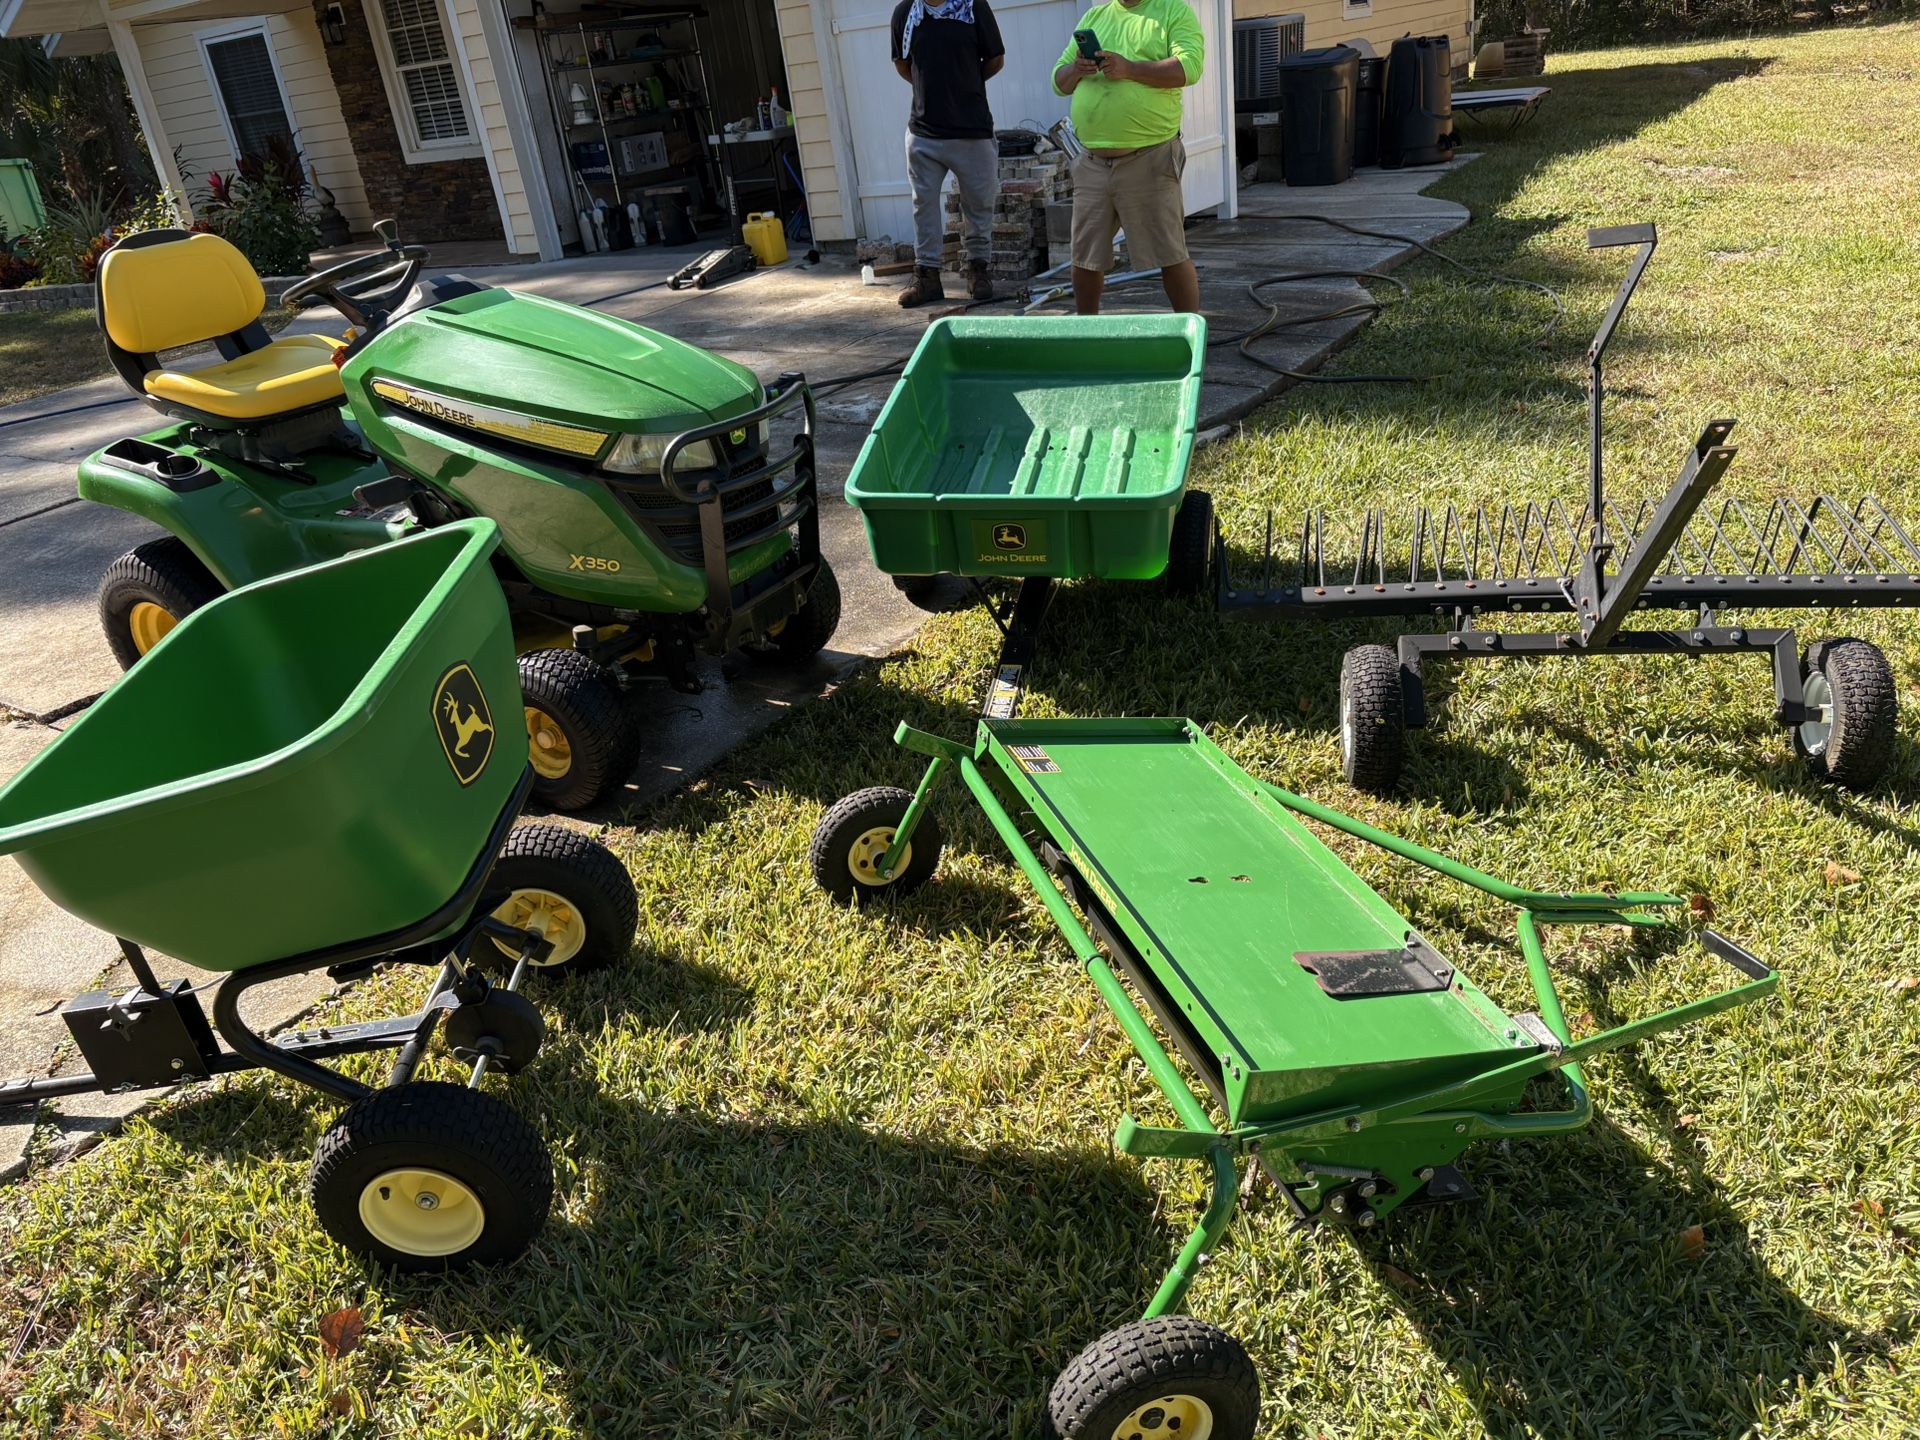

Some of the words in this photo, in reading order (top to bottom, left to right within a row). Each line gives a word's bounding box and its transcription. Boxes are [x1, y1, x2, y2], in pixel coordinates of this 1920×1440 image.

[403, 392, 433, 412] JOHN
[434, 402, 475, 426] DEERE
[568, 553, 621, 572] X350
[978, 553, 1008, 562] JOHN
[1009, 553, 1047, 562] DEERE
